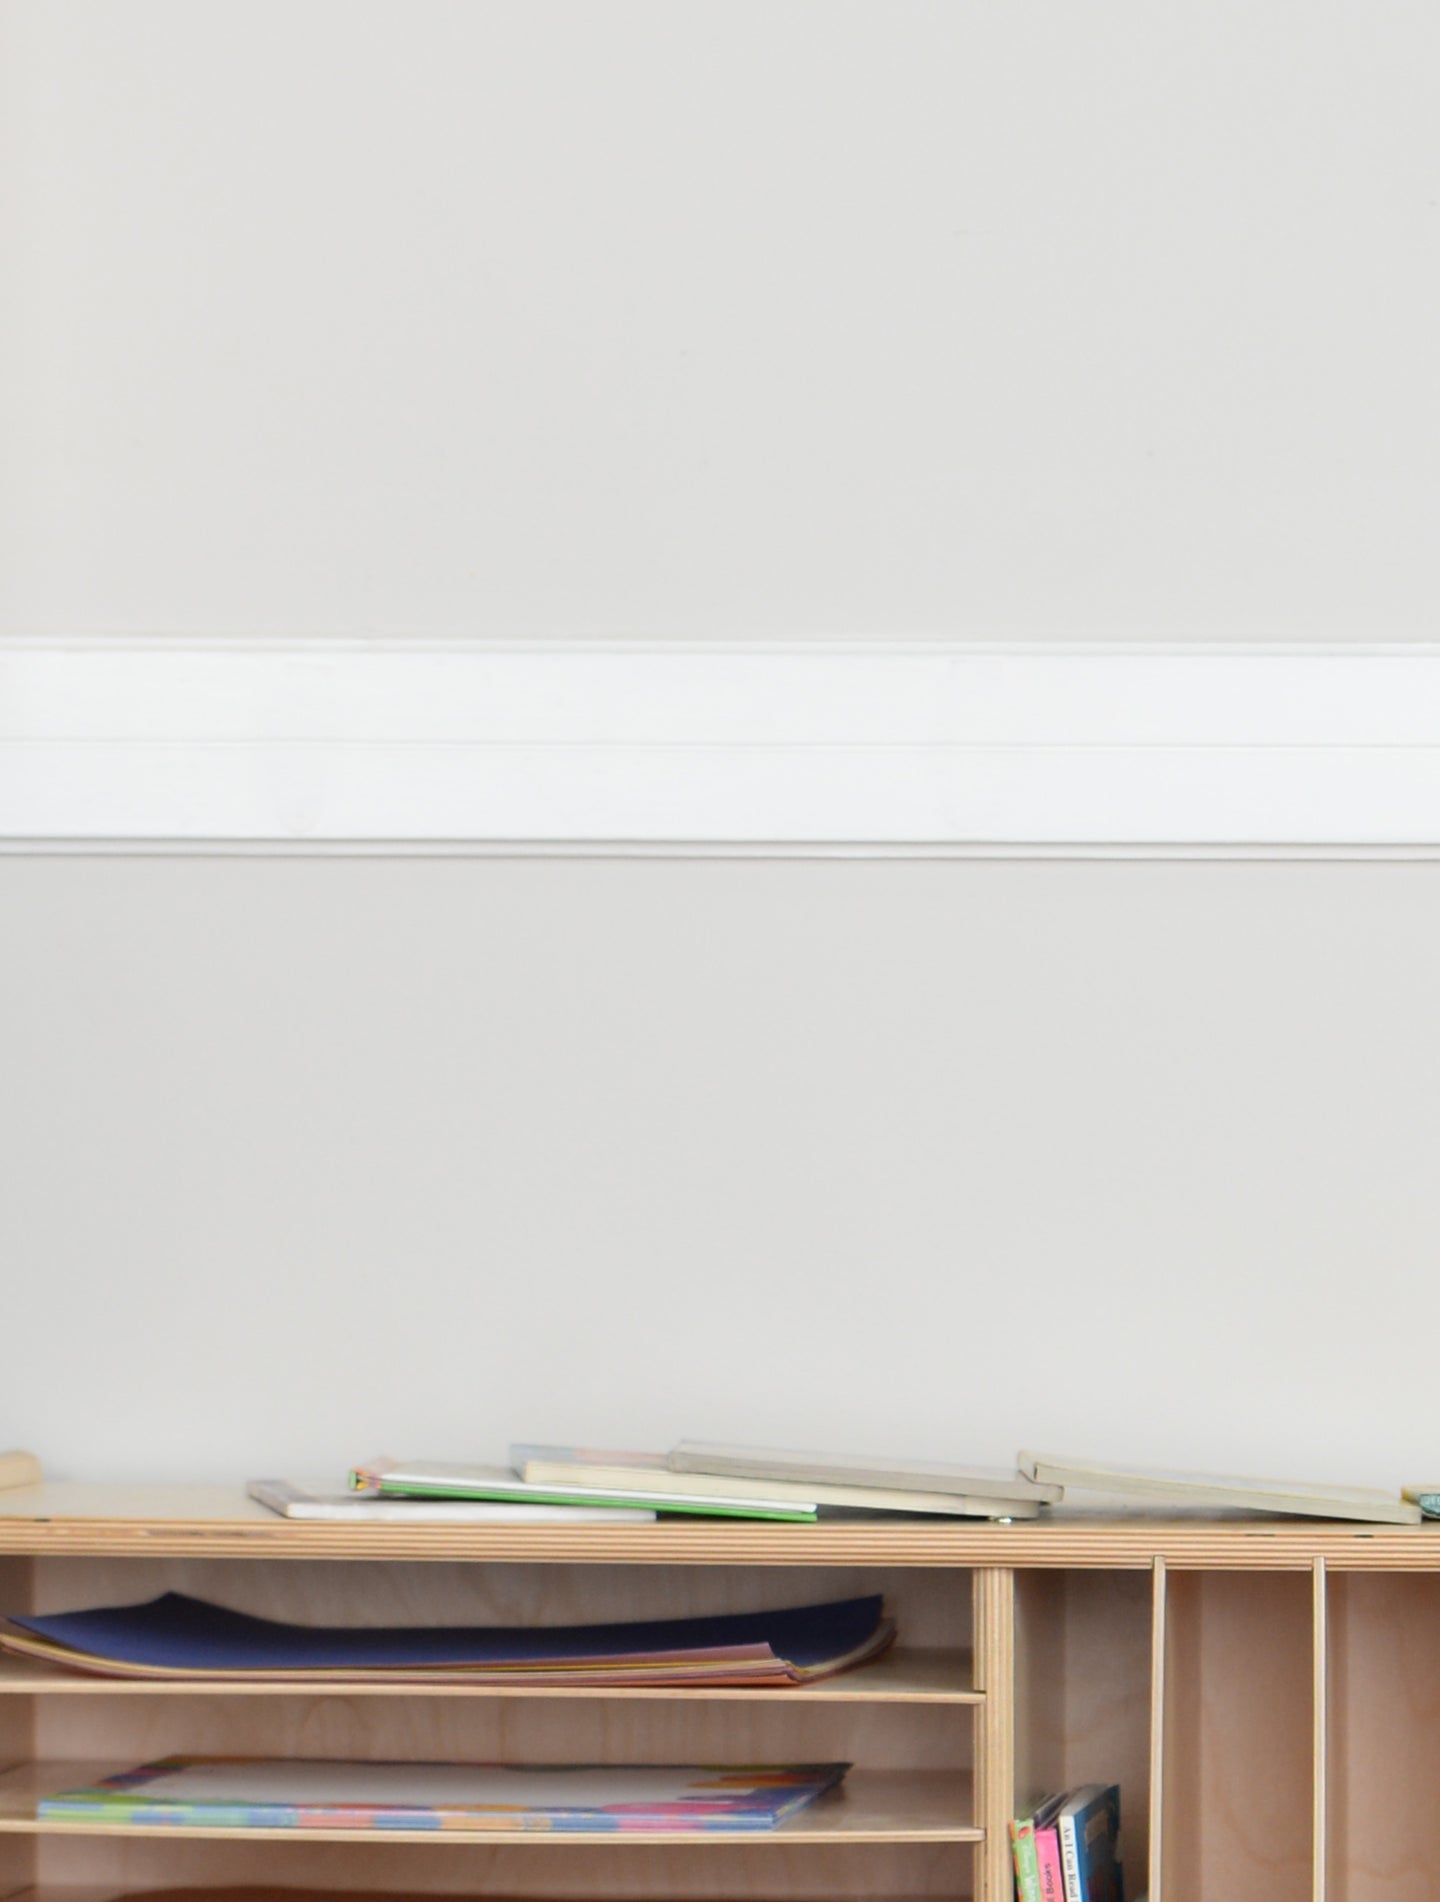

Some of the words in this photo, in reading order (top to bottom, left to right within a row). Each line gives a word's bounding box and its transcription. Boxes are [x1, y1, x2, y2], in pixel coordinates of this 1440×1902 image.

[1063, 1826, 1072, 1841] An
[1066, 1850, 1075, 1871] Can
[1044, 1863, 1055, 1895] Books
[1067, 1873, 1078, 1898] Read
